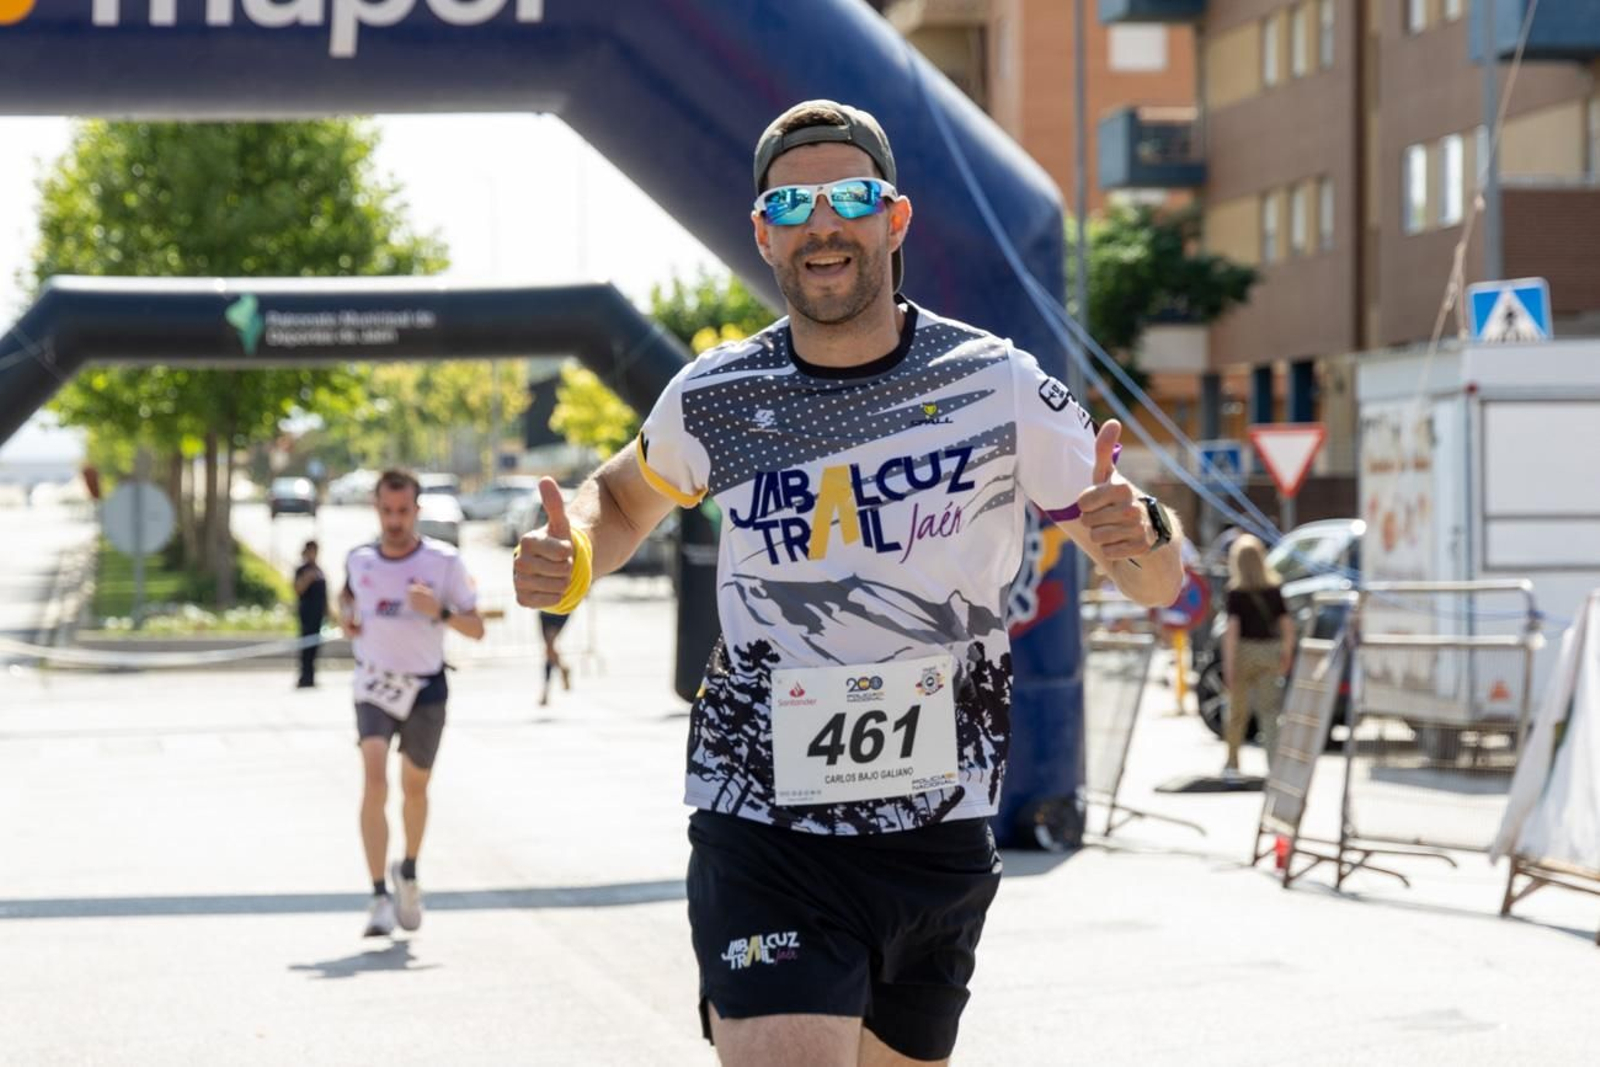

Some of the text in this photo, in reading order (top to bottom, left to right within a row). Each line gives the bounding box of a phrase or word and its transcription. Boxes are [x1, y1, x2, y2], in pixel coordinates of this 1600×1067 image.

[730, 446, 975, 529] JABALCUZ
[752, 498, 963, 566] TRAIL Jaén
[777, 697, 817, 707] Santander
[807, 704, 922, 766] 461
[825, 766, 914, 785] CARLOS BAJO GALIANO
[720, 931, 800, 961] JABALCUZ
